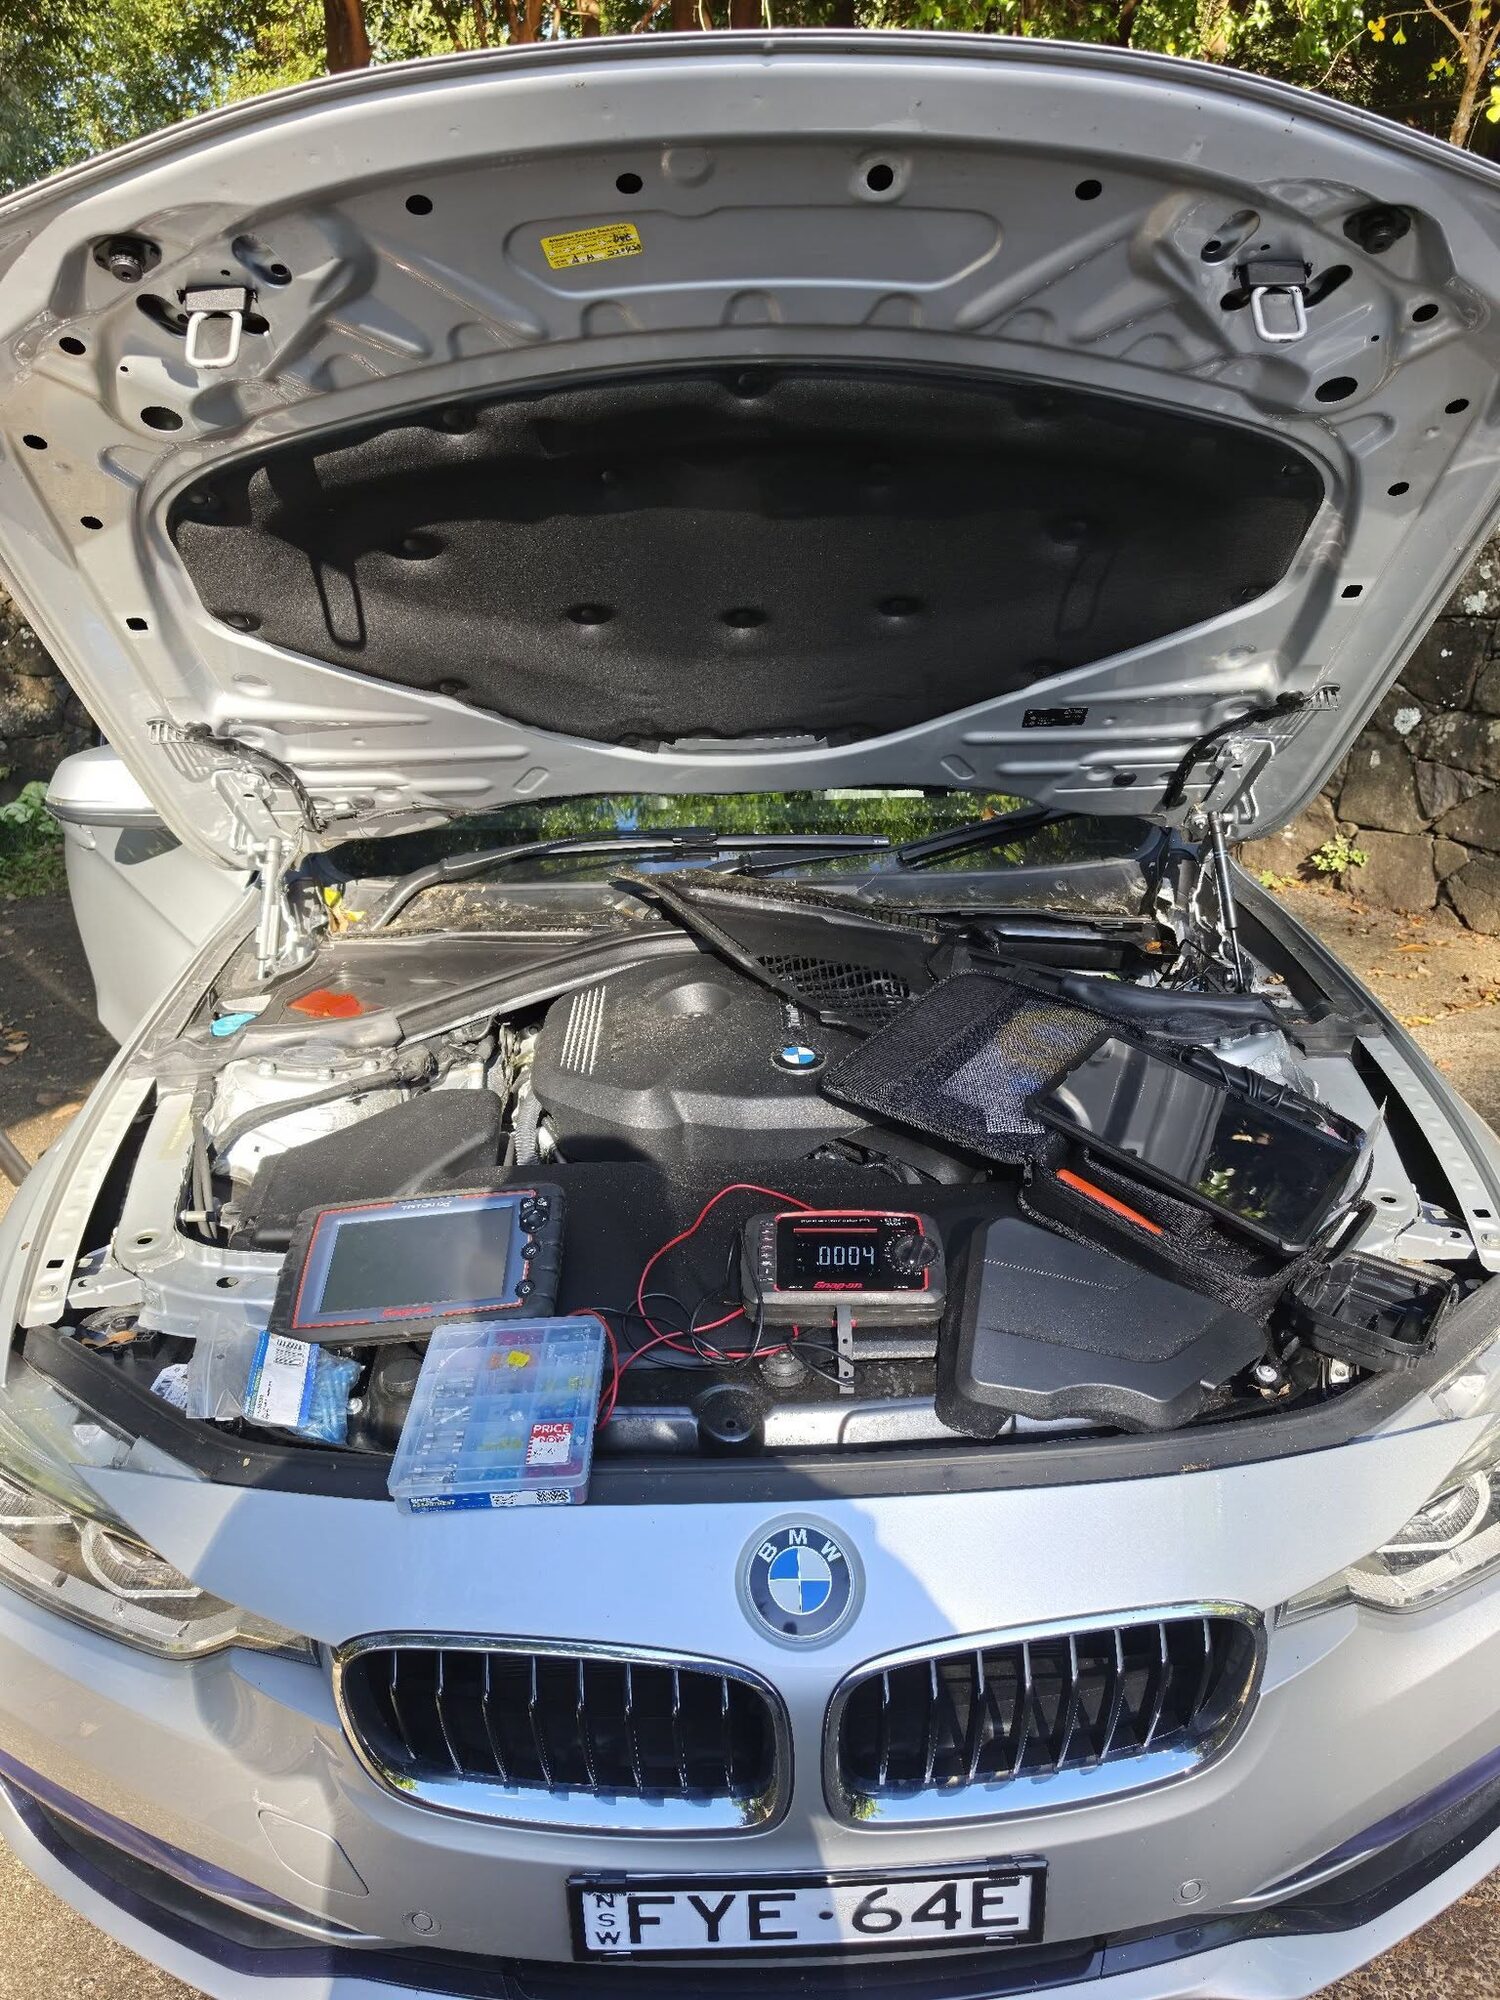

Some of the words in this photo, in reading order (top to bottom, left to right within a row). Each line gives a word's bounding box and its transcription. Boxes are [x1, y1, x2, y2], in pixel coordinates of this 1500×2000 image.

[814, 1281, 864, 1290] Snap-on
[533, 1423, 570, 1434] PRICE
[758, 1529, 842, 1564] BMW
